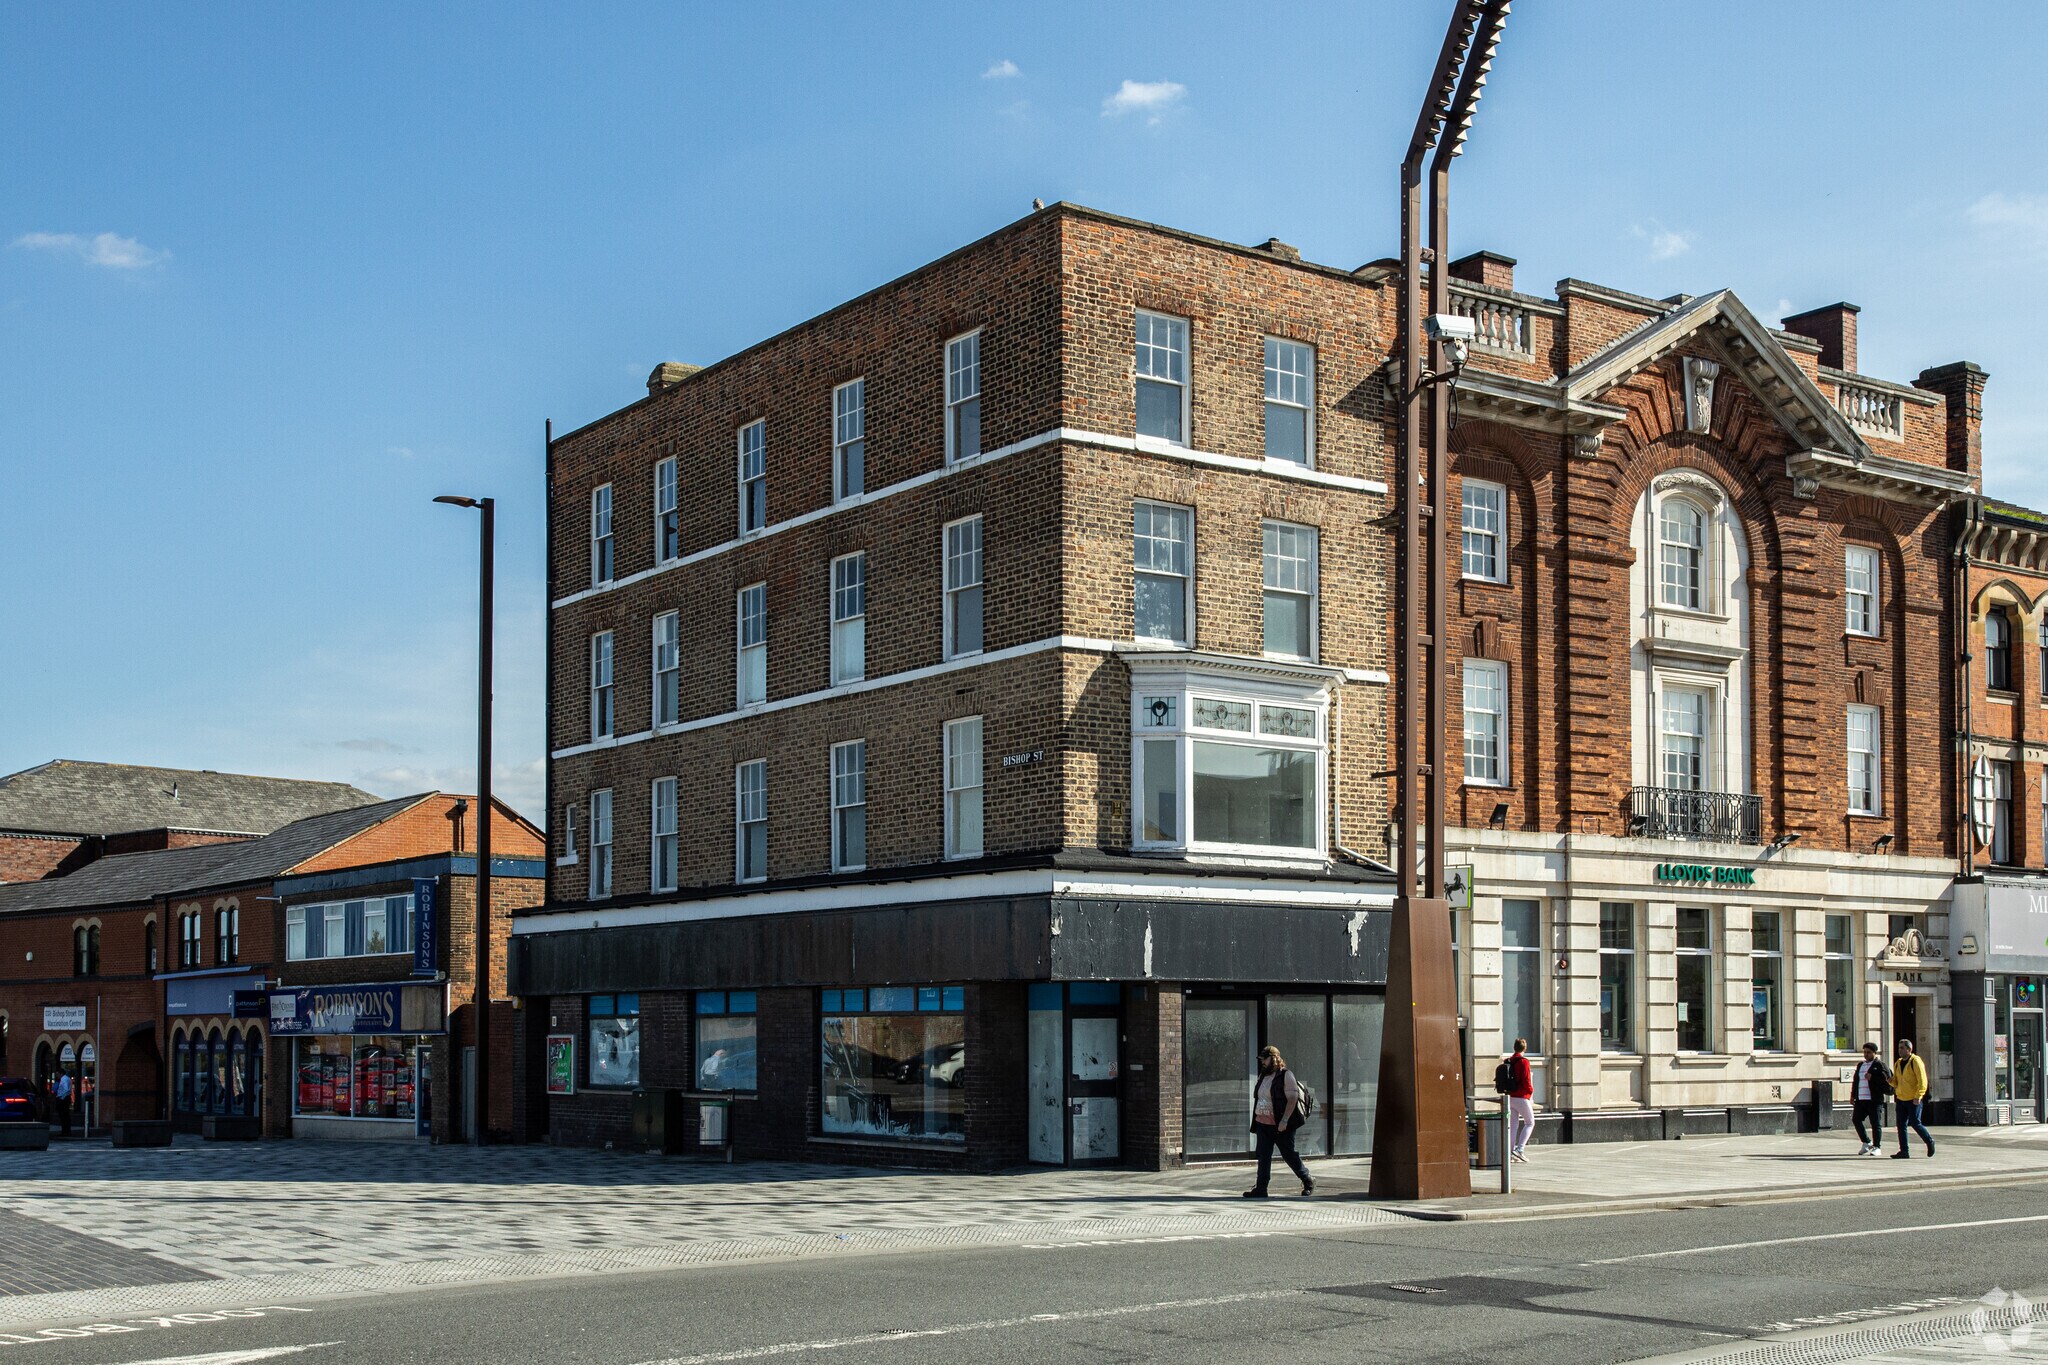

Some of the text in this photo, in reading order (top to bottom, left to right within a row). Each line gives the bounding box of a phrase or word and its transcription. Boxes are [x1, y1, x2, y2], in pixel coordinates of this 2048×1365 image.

[1003, 750, 1044, 767] BISHOP ST
[1657, 863, 1756, 884] LLOYDS BANK
[421, 885, 431, 968] ROBINSONS
[1896, 972, 1923, 982] BANK
[53, 1010, 65, 1019] Bishop
[314, 991, 394, 1028] ROBINSONS
